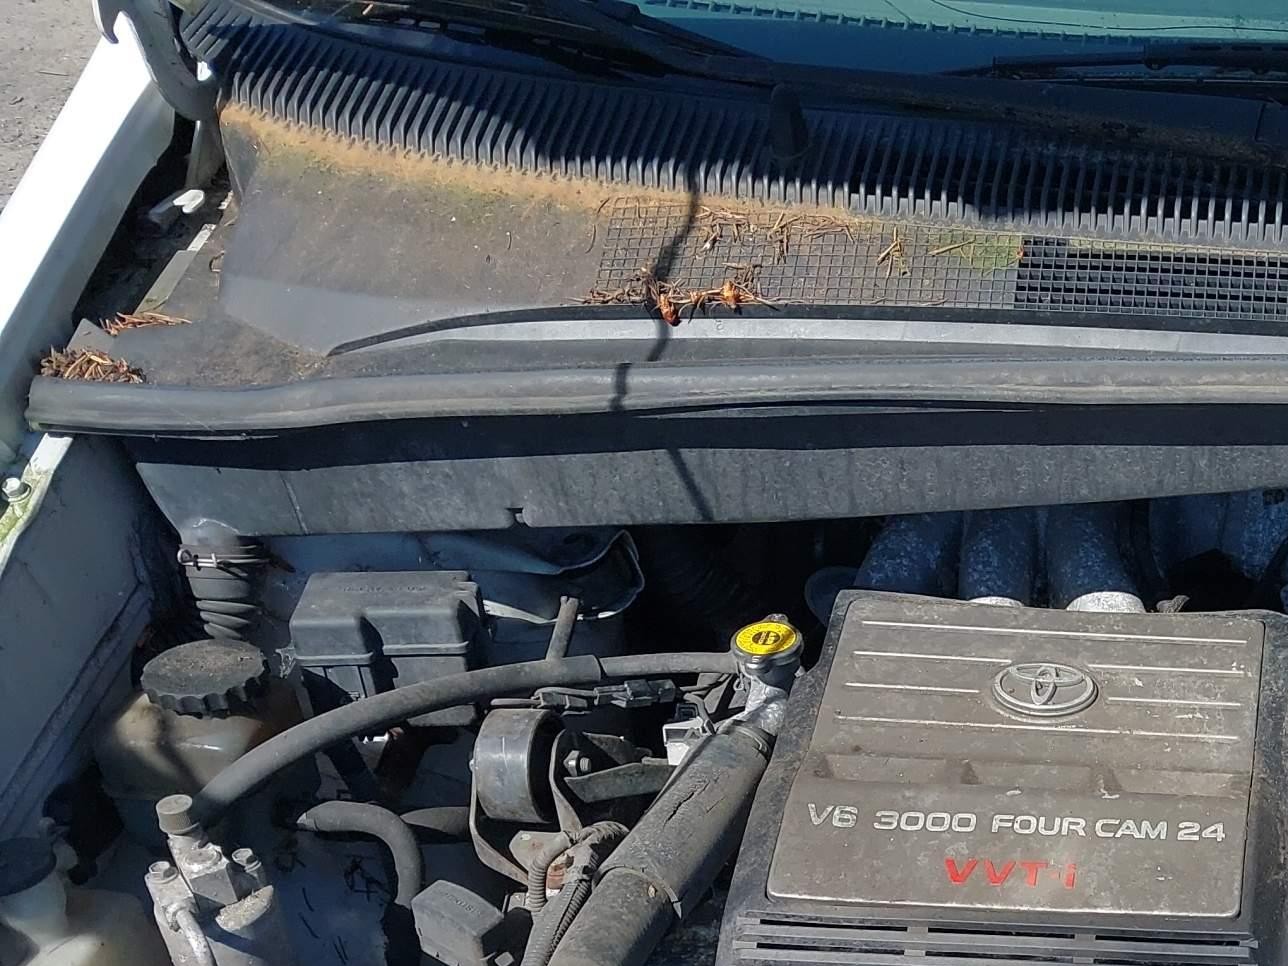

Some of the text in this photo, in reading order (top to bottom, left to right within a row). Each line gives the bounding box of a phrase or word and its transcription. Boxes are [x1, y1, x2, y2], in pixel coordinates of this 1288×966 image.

[808, 803, 1226, 842] V6 3000 FOUR CAM 24
